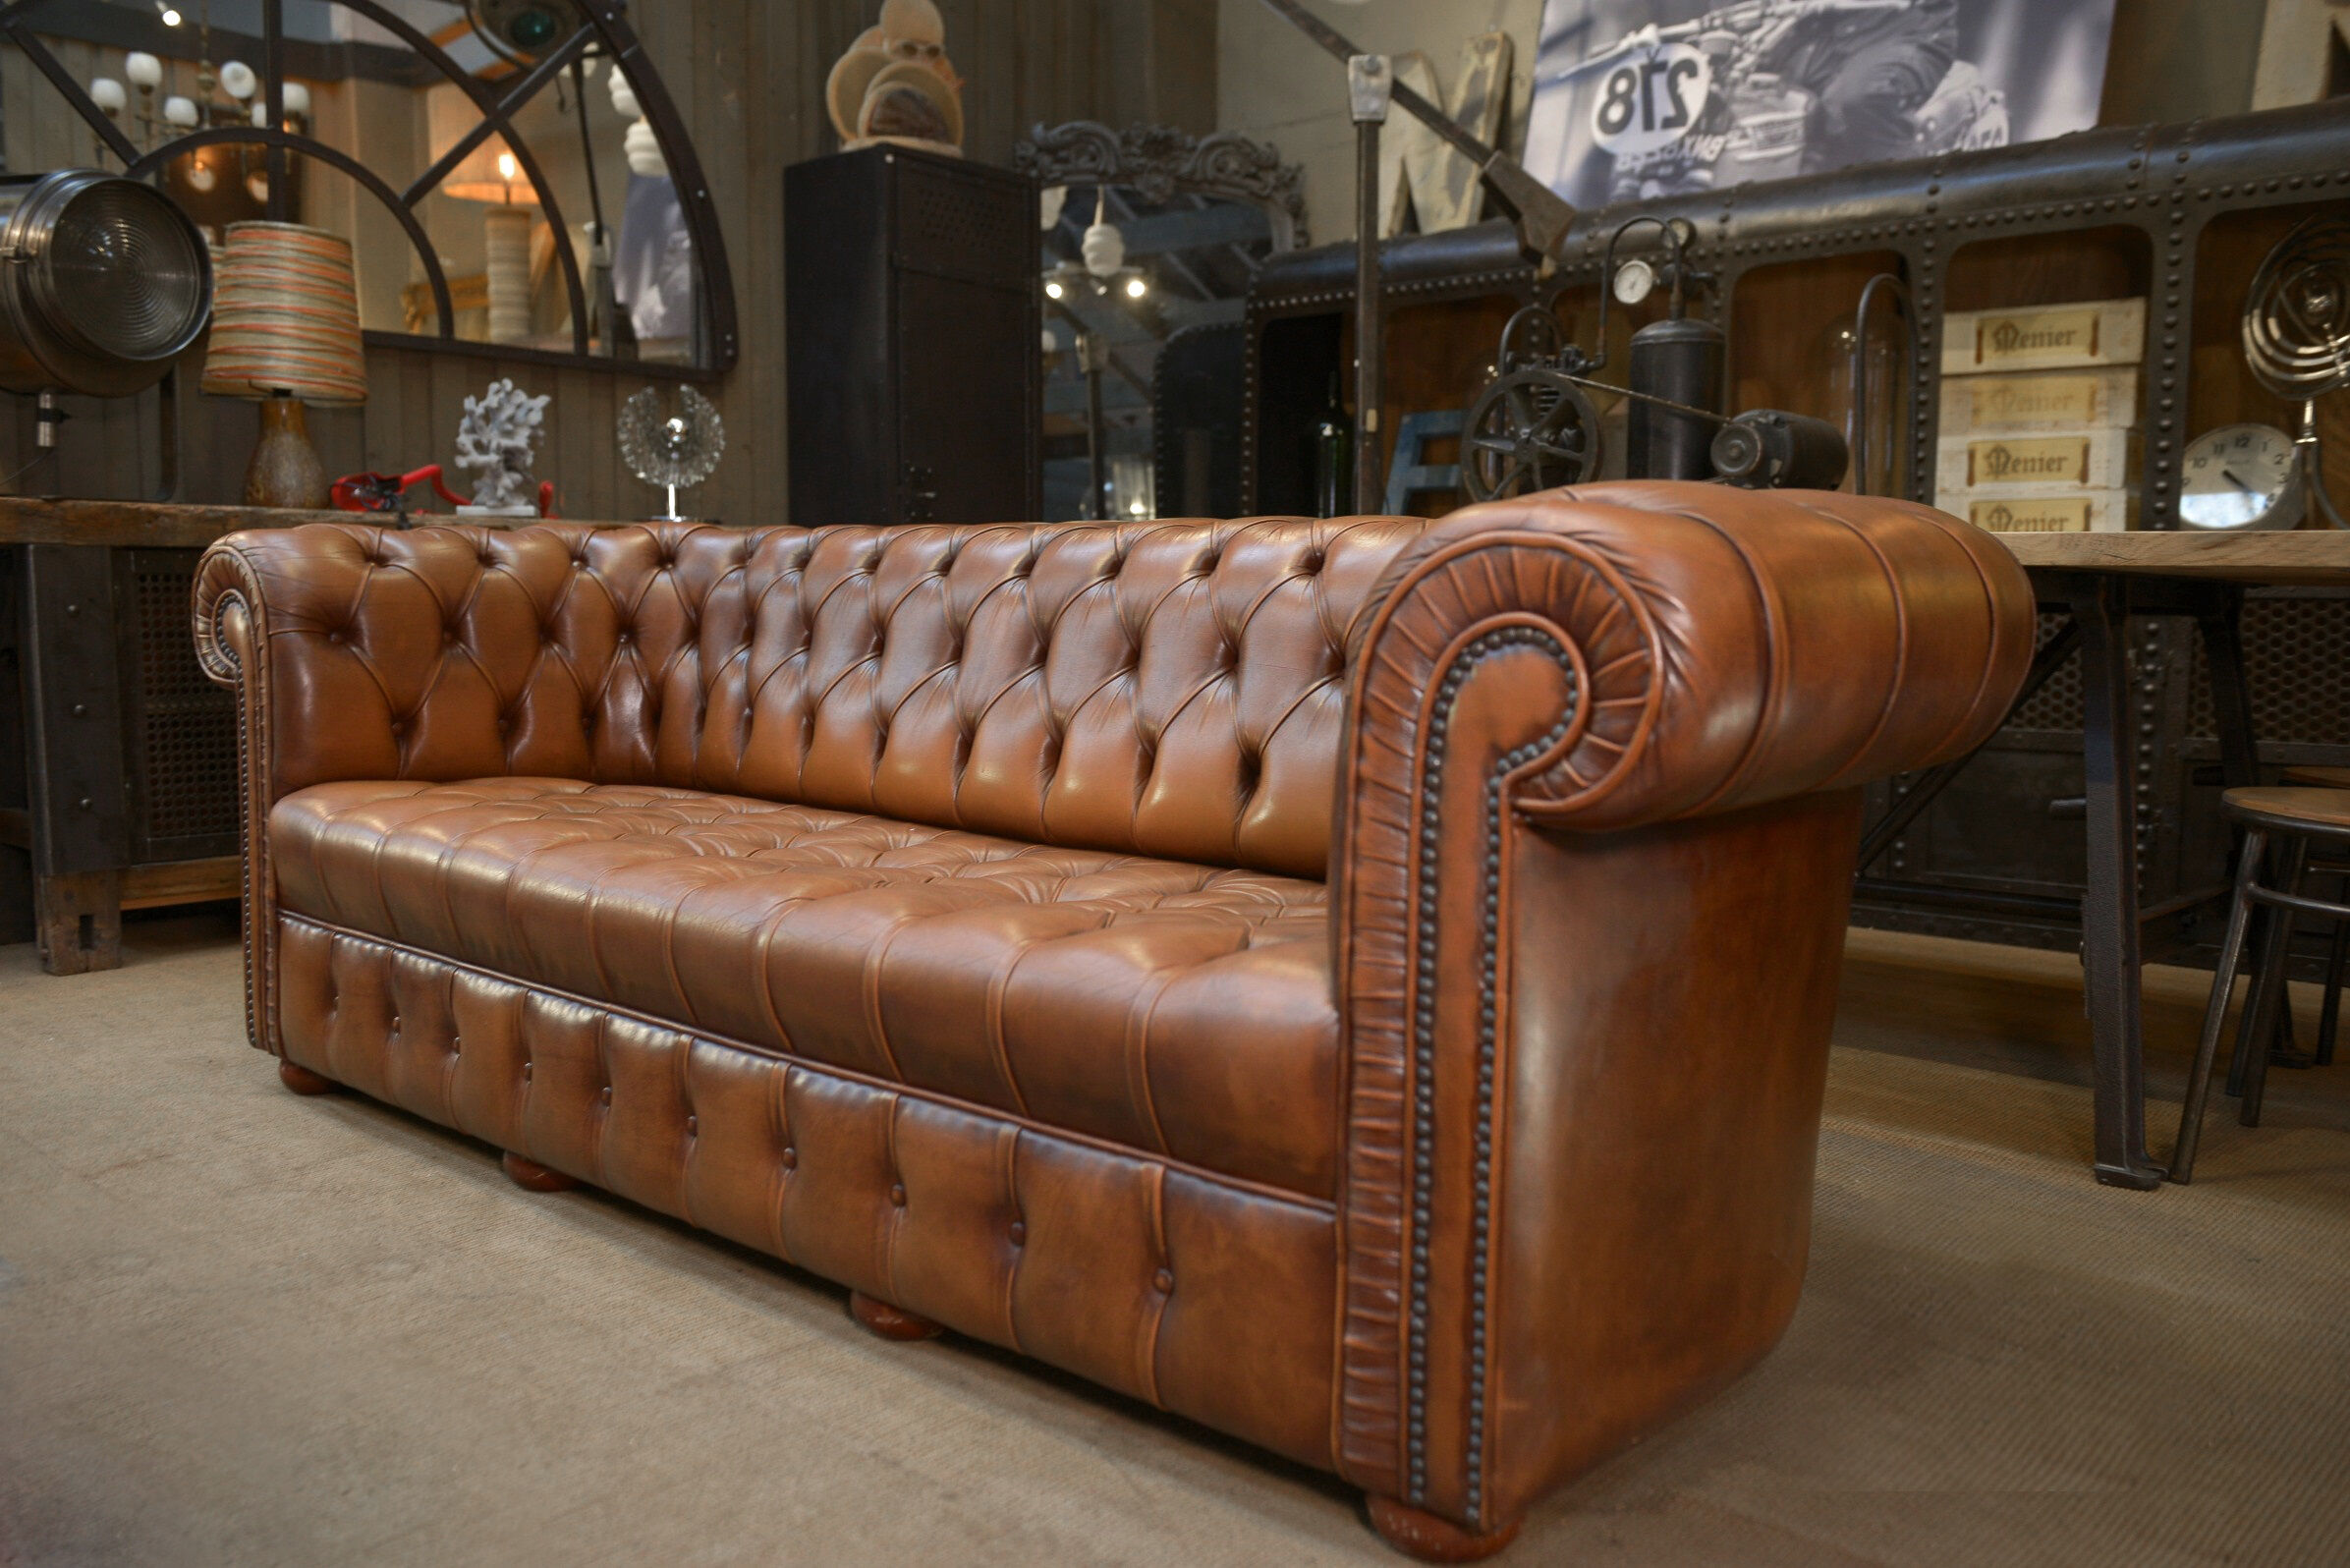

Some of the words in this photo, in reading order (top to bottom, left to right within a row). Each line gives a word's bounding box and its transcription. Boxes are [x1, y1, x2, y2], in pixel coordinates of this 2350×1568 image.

[1991, 318, 2078, 355] Menier
[2234, 433, 2251, 448] 12
[2213, 443, 2225, 455] 11
[1983, 443, 2068, 478] Menier
[2193, 456, 2208, 469] 10
[2273, 453, 2283, 465] 2
